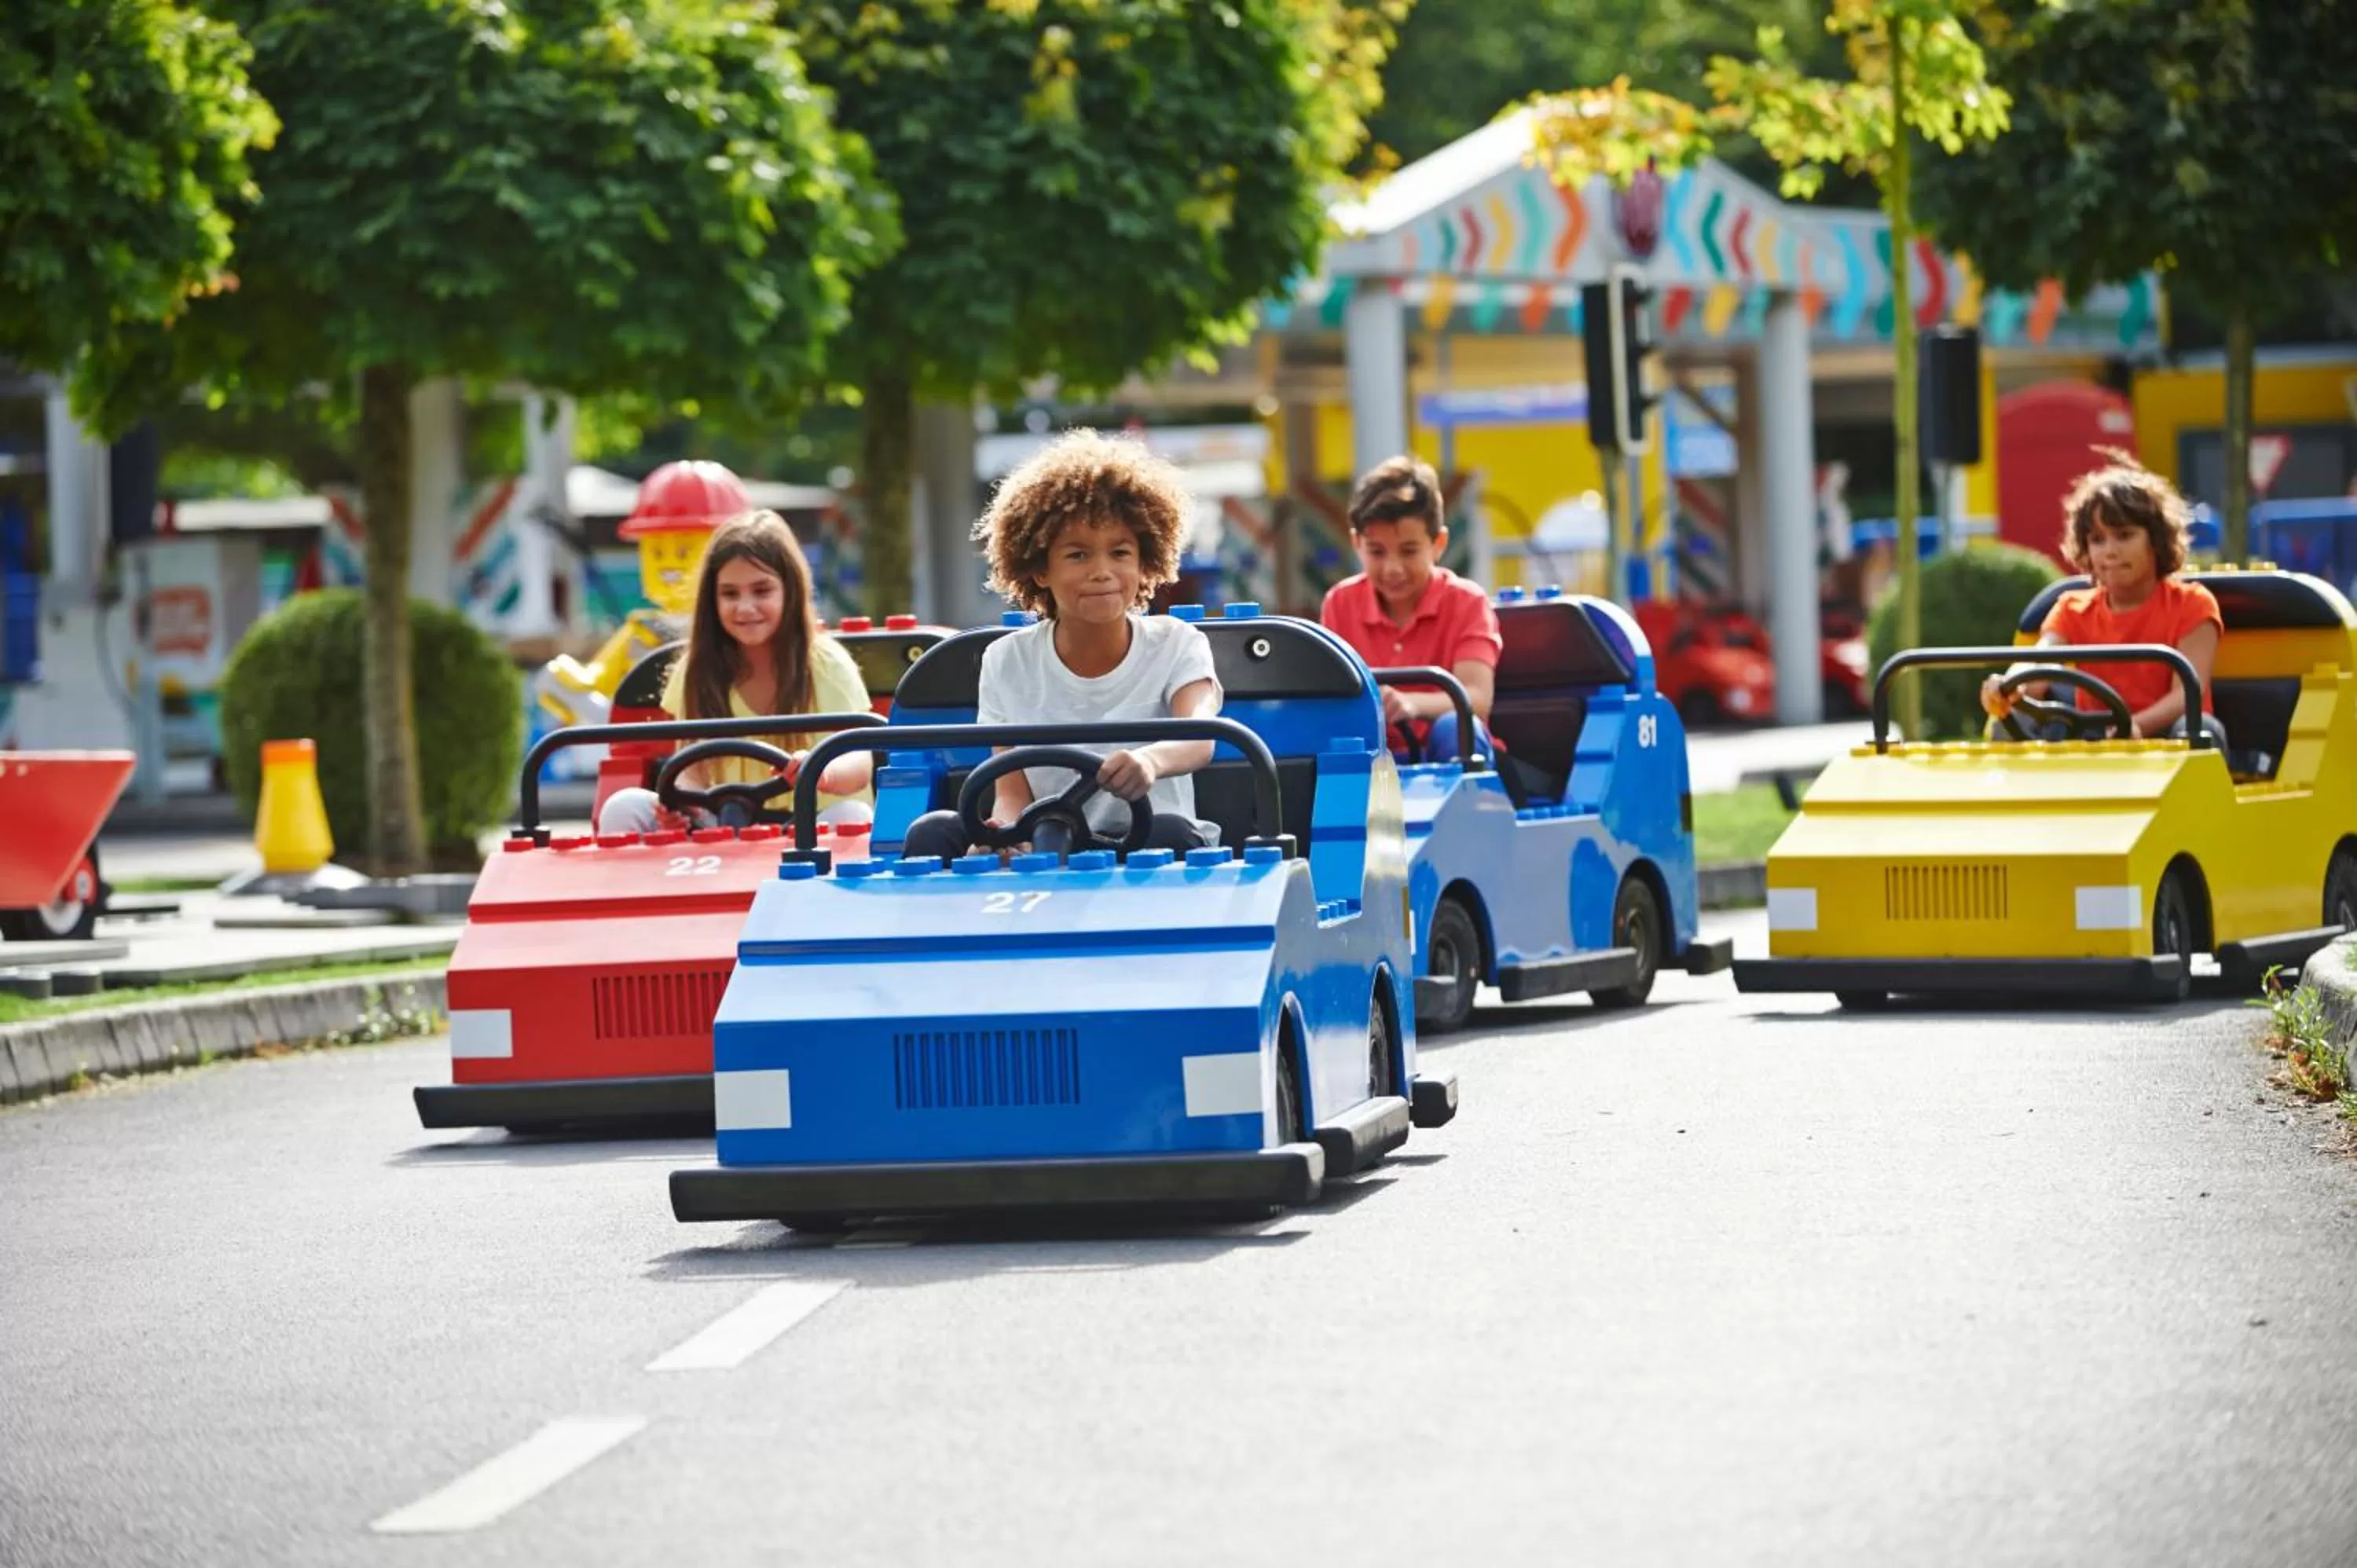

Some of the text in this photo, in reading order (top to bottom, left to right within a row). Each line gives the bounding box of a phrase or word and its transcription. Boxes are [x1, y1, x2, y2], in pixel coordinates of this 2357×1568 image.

[1638, 714, 1657, 749] 81
[665, 855, 722, 876] 22
[980, 892, 1052, 914] 27
